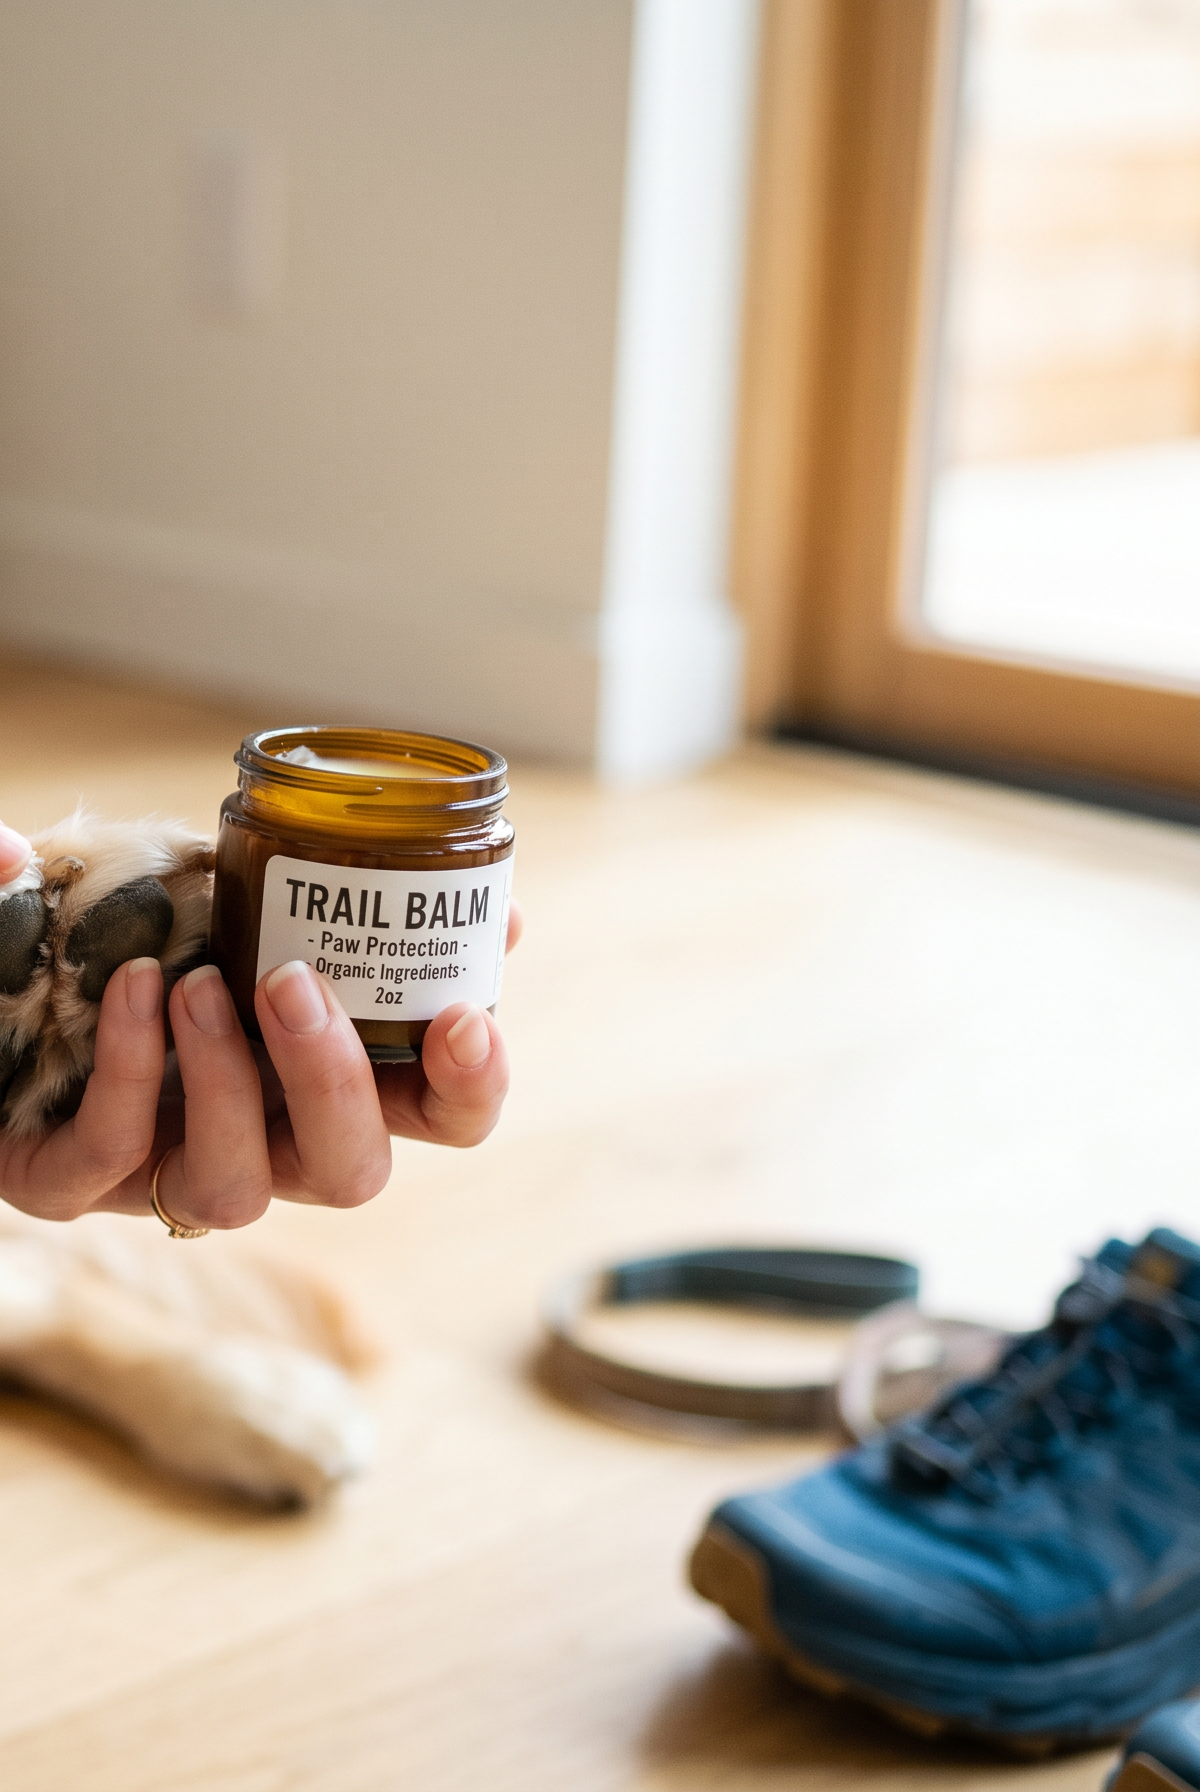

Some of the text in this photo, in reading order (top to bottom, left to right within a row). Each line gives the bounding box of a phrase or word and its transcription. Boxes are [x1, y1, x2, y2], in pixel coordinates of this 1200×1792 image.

[285, 877, 490, 930] TRAIL BALM
[320, 930, 361, 955] Paw
[365, 935, 458, 957] Protection
[315, 956, 376, 981] Organic
[380, 963, 459, 985] Ingredients
[374, 986, 404, 1005] 2oz
